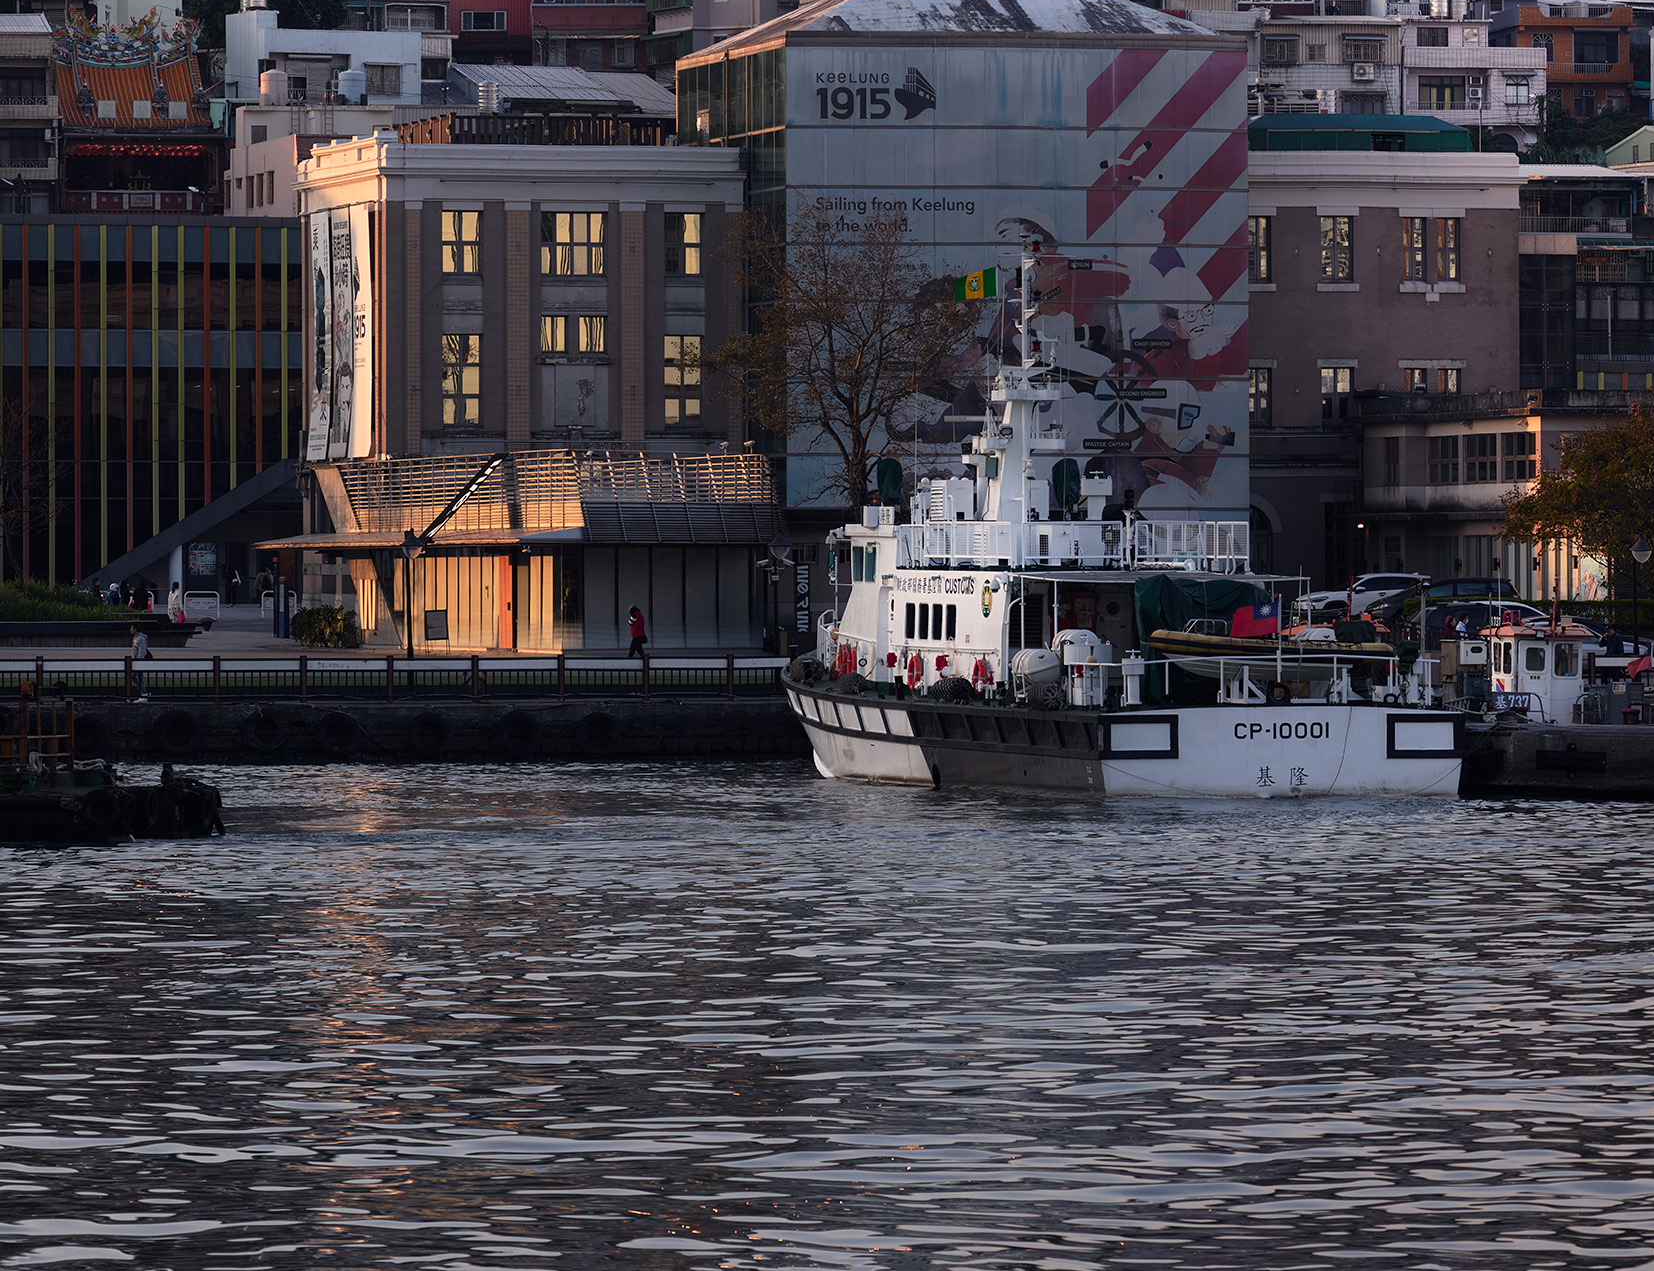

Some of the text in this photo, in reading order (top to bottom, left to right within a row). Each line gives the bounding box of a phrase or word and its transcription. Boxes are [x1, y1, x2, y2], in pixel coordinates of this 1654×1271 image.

[816, 87, 891, 120] 1915
[816, 197, 975, 215] Sailing from Keelung
[835, 215, 860, 232] the
[1234, 721, 1330, 740] CP-10001
[1256, 765, 1310, 788] 基隆
